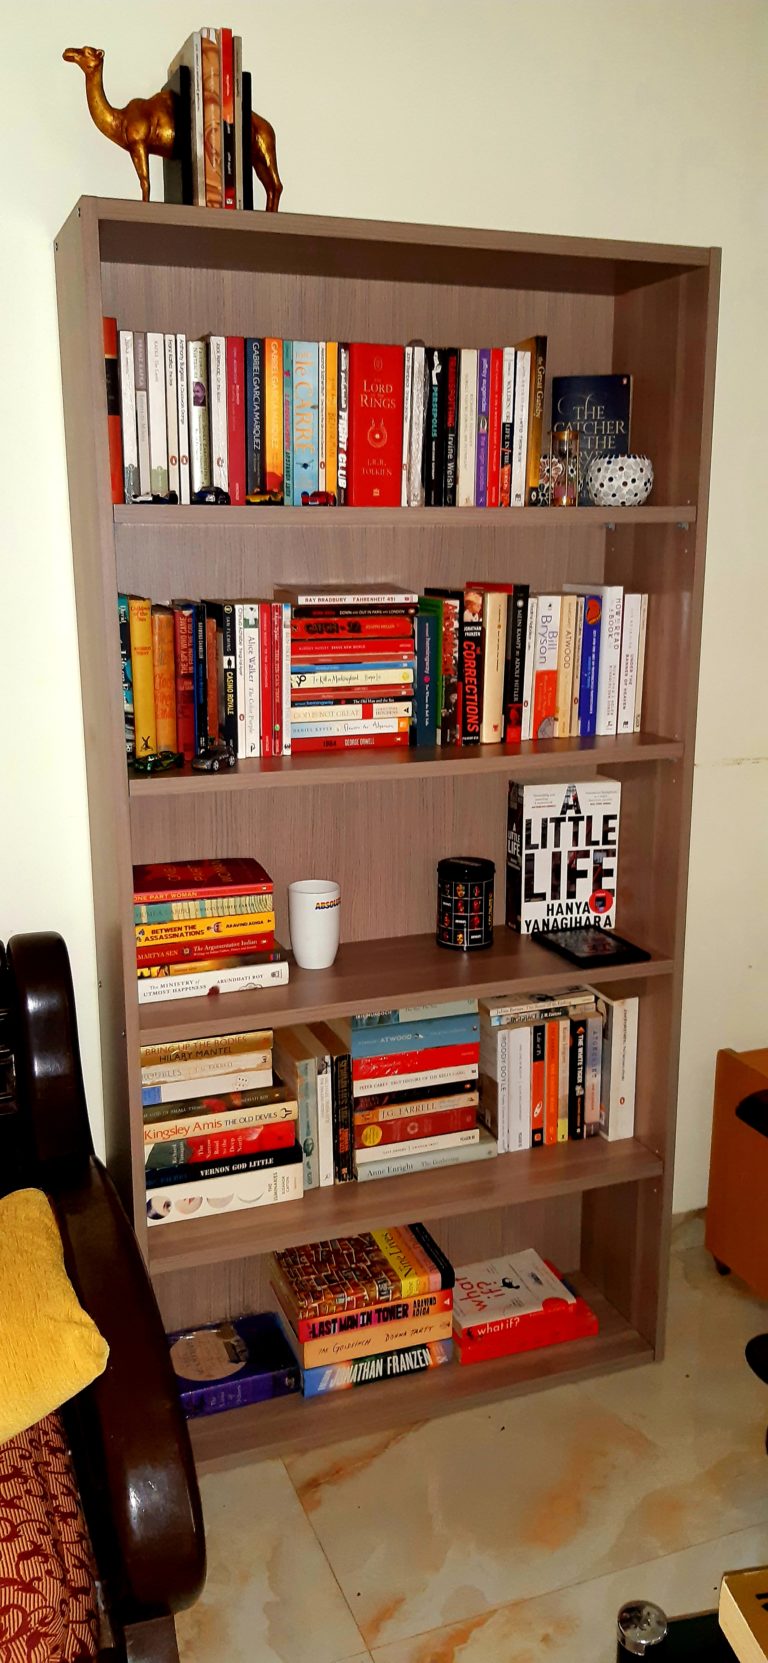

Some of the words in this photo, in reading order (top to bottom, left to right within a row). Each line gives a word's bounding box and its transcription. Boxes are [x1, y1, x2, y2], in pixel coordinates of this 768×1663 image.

[252, 342, 260, 377] GABRIEL
[271, 342, 279, 376] GABRIEL
[295, 360, 314, 376] le
[363, 379, 393, 394] LORD
[537, 366, 545, 389] Great
[360, 394, 396, 409] RINGS
[447, 356, 456, 428] TRAINSPOTTING
[534, 390, 544, 418] Gatsby
[573, 393, 606, 420] THE
[338, 410, 349, 451] FIGHT
[554, 421, 627, 435] CATCHER
[447, 433, 456, 460] Irvine
[584, 436, 617, 449] THE
[338, 453, 348, 489] CLUB
[362, 467, 392, 477] TOLKIEN
[446, 462, 455, 488] Welsh
[180, 617, 188, 634] CAME
[180, 635, 188, 649] WHO
[247, 636, 256, 655] Alice
[538, 614, 553, 664] Bryson
[548, 631, 558, 650] Bill
[613, 625, 621, 650] READ
[180, 650, 188, 662] SPY
[563, 630, 572, 669] ATWOOD
[180, 662, 188, 674] THE
[248, 656, 256, 682] Walker
[226, 671, 234, 692] CASINO
[463, 640, 479, 733] CORRECTIONS
[319, 710, 335, 718] NOT
[336, 709, 360, 717] GREAT
[360, 738, 375, 746] ORWELL
[560, 783, 582, 816] A
[512, 822, 517, 831] A
[524, 814, 618, 852] LITTLE
[507, 831, 521, 843] LITTLE
[507, 841, 521, 858] LIFE
[523, 848, 618, 904] LIFE
[171, 892, 198, 900] WOMAN
[546, 901, 591, 917] HANYA
[151, 926, 182, 935] BETWEEN
[226, 921, 249, 929] ARAVIND
[249, 919, 264, 927] ADIGA
[524, 914, 612, 933] YANAGIHARA
[144, 930, 205, 942] ASSASSINATIONS
[165, 949, 178, 957] SEN
[193, 945, 204, 953] The
[204, 941, 240, 952] Argumentative
[240, 939, 258, 948] Indian
[160, 980, 194, 989] MINISTRY
[217, 976, 250, 985] ARUNDHATI
[143, 988, 172, 997] UTMOST
[172, 984, 207, 994] HAPPINESS
[145, 1045, 175, 1057] BRING
[177, 1043, 192, 1053] UP
[193, 1040, 213, 1050] THE
[215, 1035, 248, 1047] BODIES
[380, 1034, 412, 1044] ATWOOD
[159, 1050, 193, 1063] HILARY
[195, 1045, 233, 1057] MANTEL
[380, 1108, 398, 1121] J.G.
[398, 1102, 437, 1116] FARRELL
[144, 1124, 191, 1142] Kingsley
[192, 1118, 224, 1132] Amis
[224, 1117, 239, 1127] THE
[239, 1114, 254, 1124] OLD
[254, 1111, 279, 1122] DEVILS
[200, 1165, 230, 1177] VERNON
[231, 1162, 248, 1172] GOD
[249, 1157, 275, 1169] LITTLE
[367, 1167, 386, 1178] Anne
[387, 1162, 414, 1175] Enright
[455, 1276, 488, 1312] what
[476, 1281, 506, 1300] if?
[412, 1296, 437, 1308] ARAVIND
[412, 1306, 431, 1317] ADIGA
[310, 1319, 339, 1339] LAST
[339, 1314, 360, 1333] MAN
[359, 1310, 373, 1327] IN
[374, 1302, 409, 1323] TOWER
[477, 1322, 504, 1336] what
[505, 1317, 520, 1329] if?
[333, 1338, 372, 1354] GOLDFINCH
[384, 1331, 407, 1343] DONNA
[408, 1324, 435, 1337] TARTT
[331, 1359, 384, 1387] JONATHAN
[386, 1348, 432, 1376] FRANZEN
